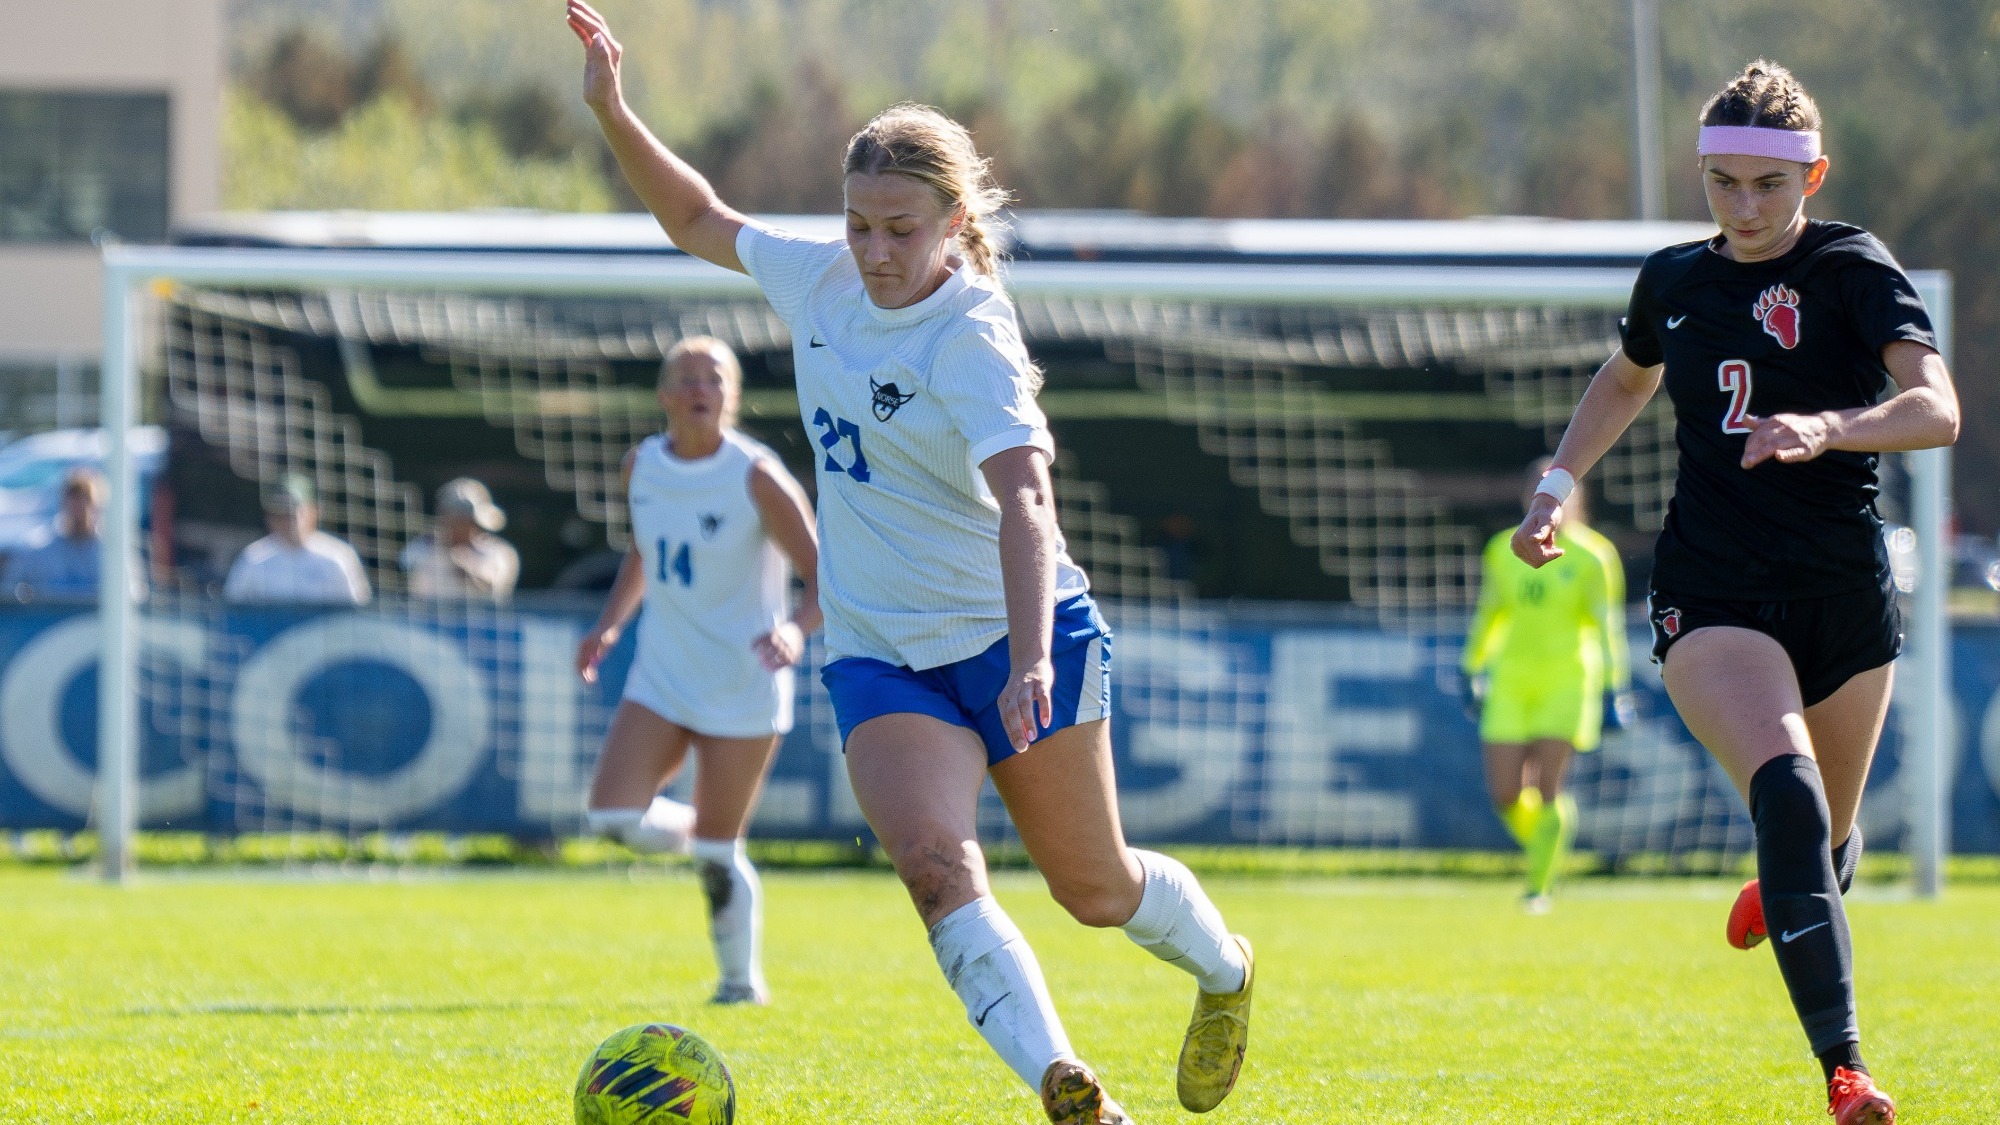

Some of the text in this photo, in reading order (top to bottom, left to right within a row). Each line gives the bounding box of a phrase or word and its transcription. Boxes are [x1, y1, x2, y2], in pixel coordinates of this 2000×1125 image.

[875, 391, 899, 407] NORSE
[1718, 360, 1753, 434] 2
[813, 407, 870, 483] 27
[656, 537, 693, 587] 14
[0, 612, 1416, 837] COLGE
